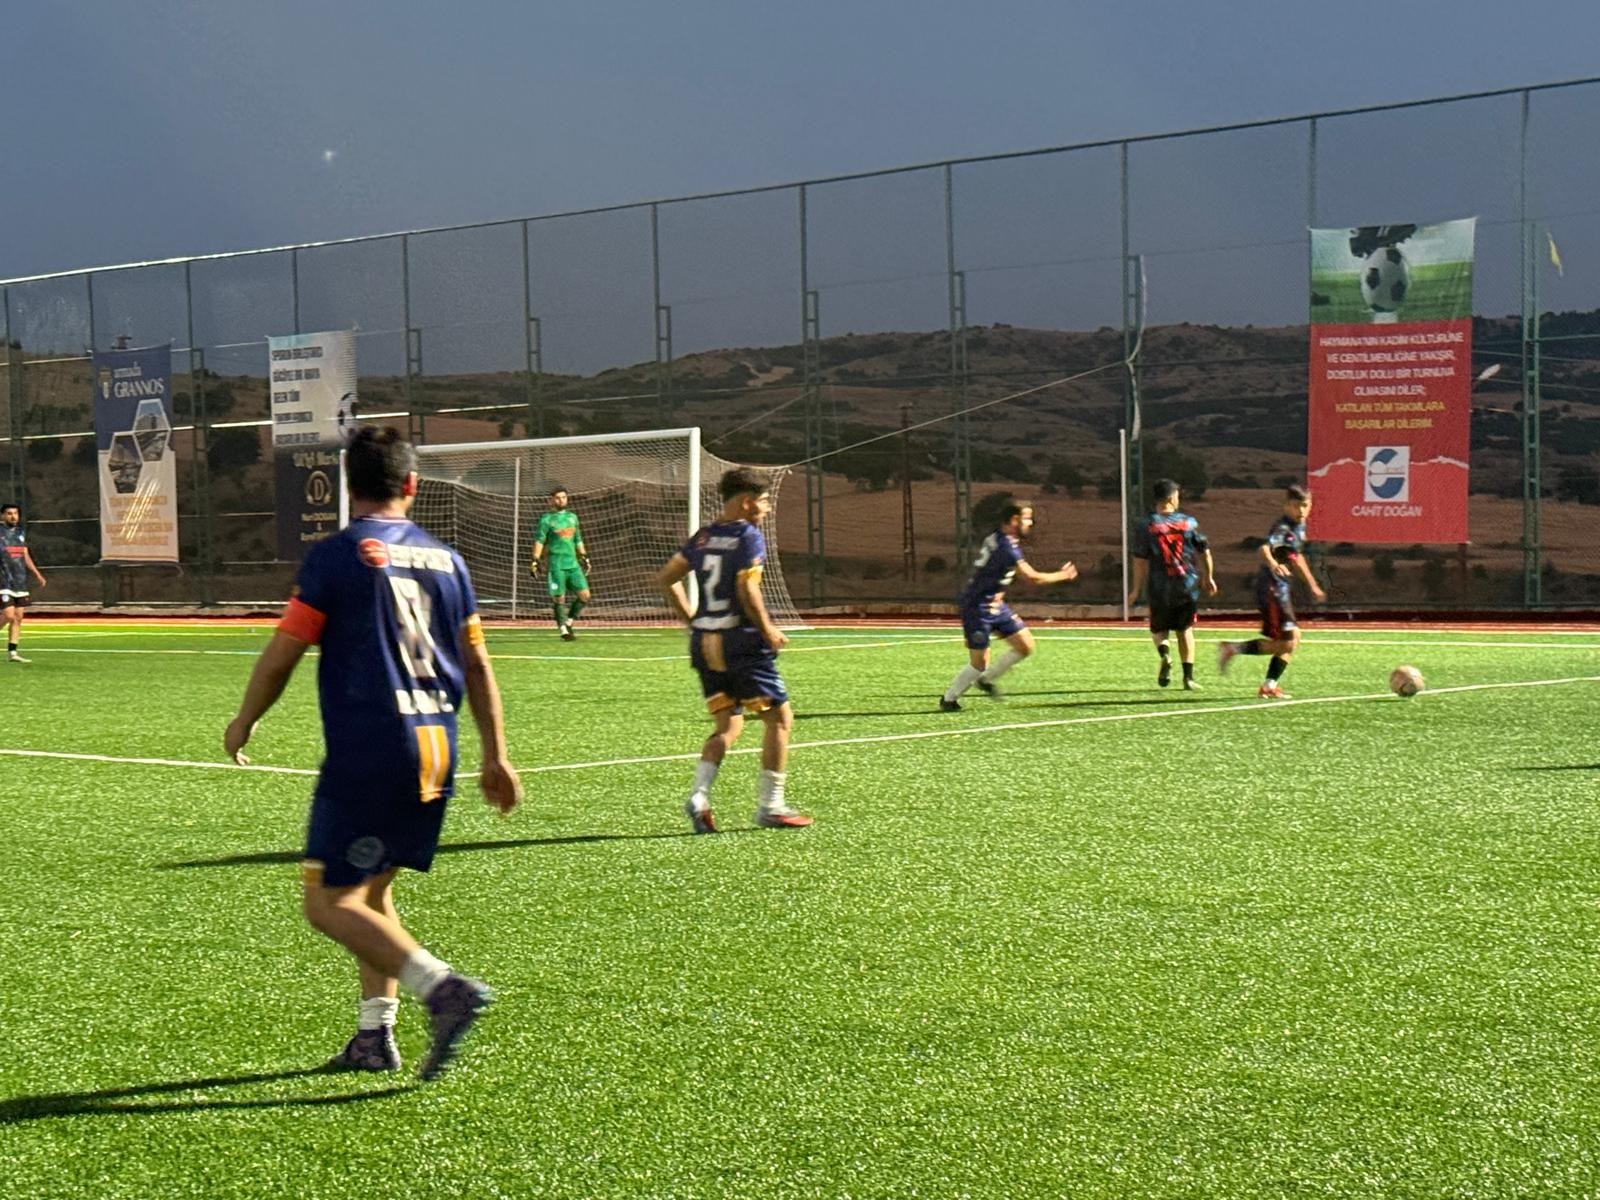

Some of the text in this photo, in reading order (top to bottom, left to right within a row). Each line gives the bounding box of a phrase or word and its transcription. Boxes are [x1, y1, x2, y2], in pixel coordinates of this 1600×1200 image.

[1327, 353, 1339, 363] VE
[1327, 369, 1368, 380] DOSTLUK
[702, 553, 731, 613] 2
